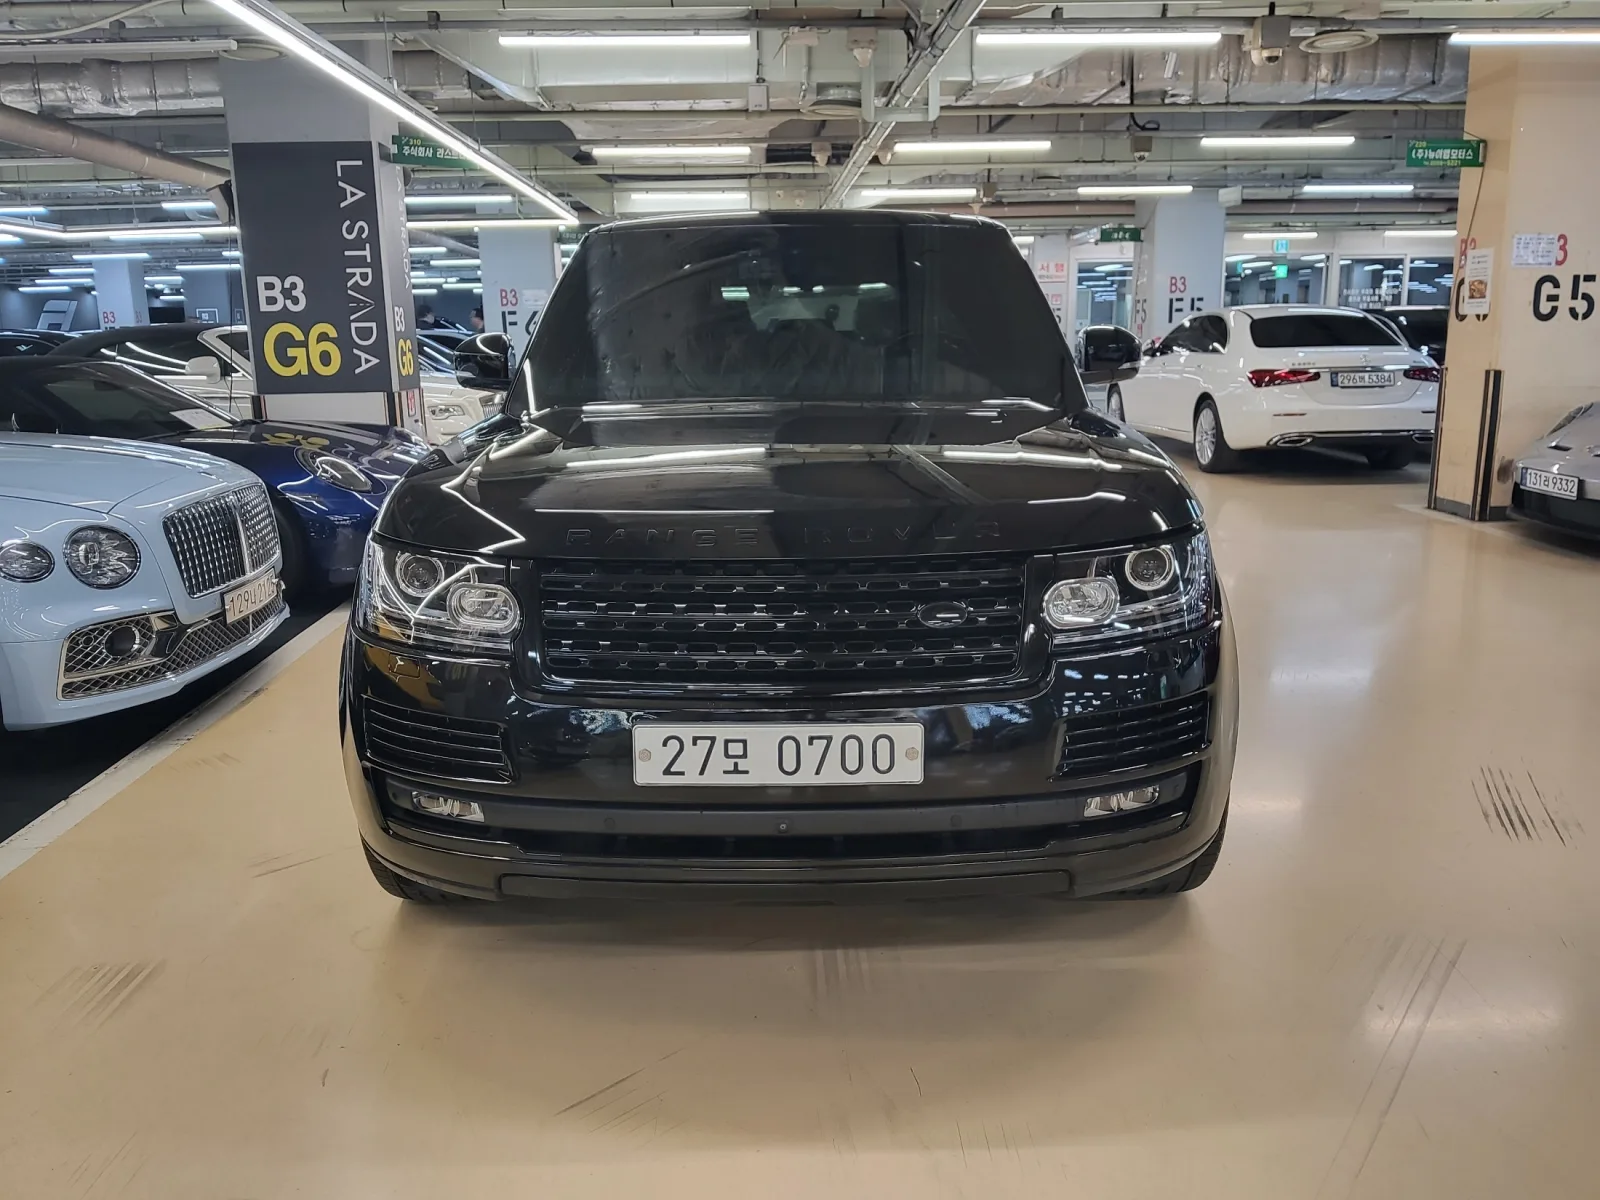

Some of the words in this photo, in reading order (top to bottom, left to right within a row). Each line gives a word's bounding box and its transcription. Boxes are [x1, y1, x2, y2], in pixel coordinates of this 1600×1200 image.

[402, 146, 434, 158] 주식회사
[337, 160, 366, 208] LA
[1555, 233, 1568, 266] 3
[256, 275, 307, 312] B3
[342, 220, 381, 375] STRADA
[500, 288, 519, 307] B3
[1169, 276, 1187, 293] B3
[1532, 274, 1597, 321] G5
[103, 311, 116, 324] B3
[394, 306, 405, 332] B3
[263, 322, 342, 377] G6
[398, 338, 414, 376] G6
[1367, 373, 1393, 385] 5384
[1551, 476, 1576, 494] 9332
[566, 528, 759, 546] RANGE
[661, 735, 750, 776] 27모
[777, 734, 896, 776] 0700
